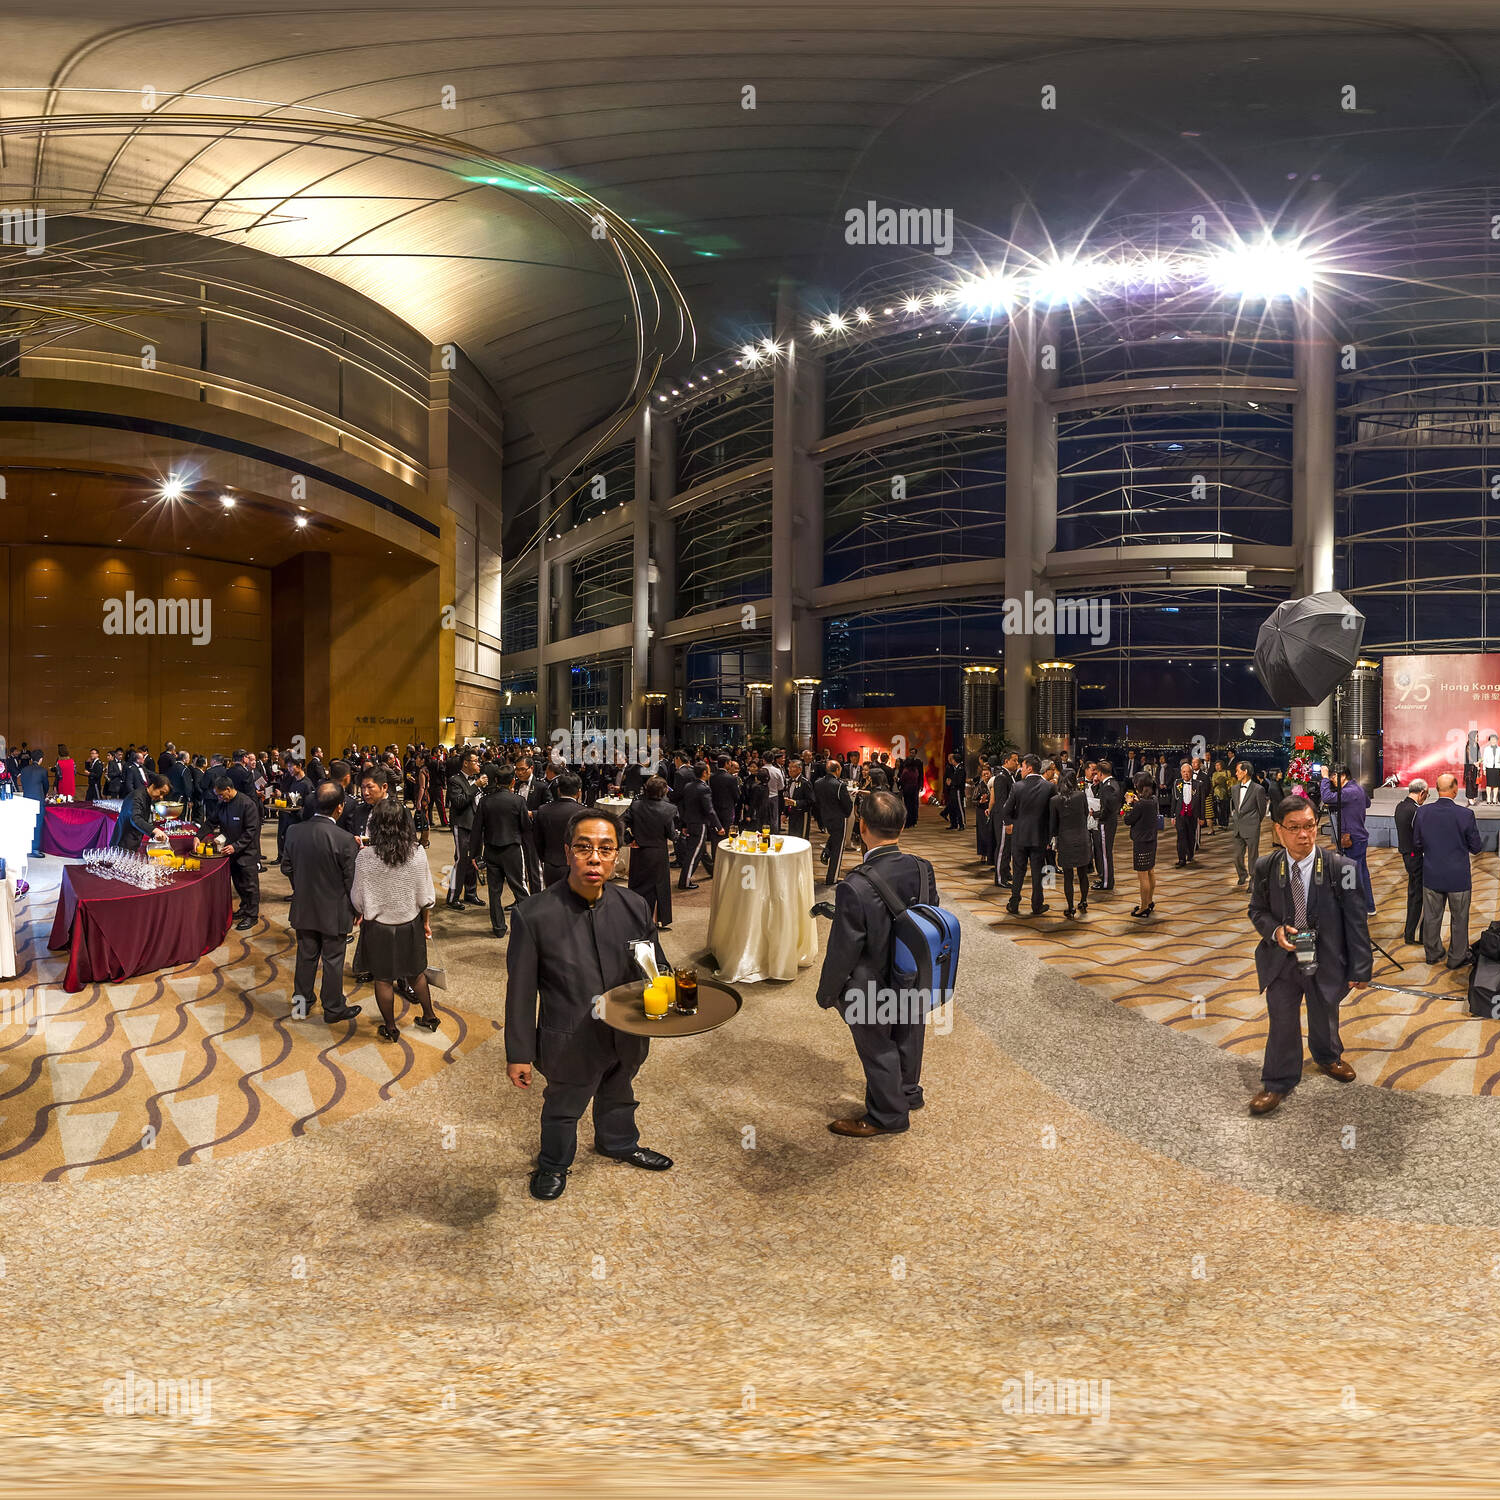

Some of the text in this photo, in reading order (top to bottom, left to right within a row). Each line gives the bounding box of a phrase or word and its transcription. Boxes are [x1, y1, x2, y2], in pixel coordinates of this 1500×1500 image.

[1440, 683, 1469, 692] Hong
[1472, 682, 1500, 692] Kong
[822, 715, 840, 733] 95
